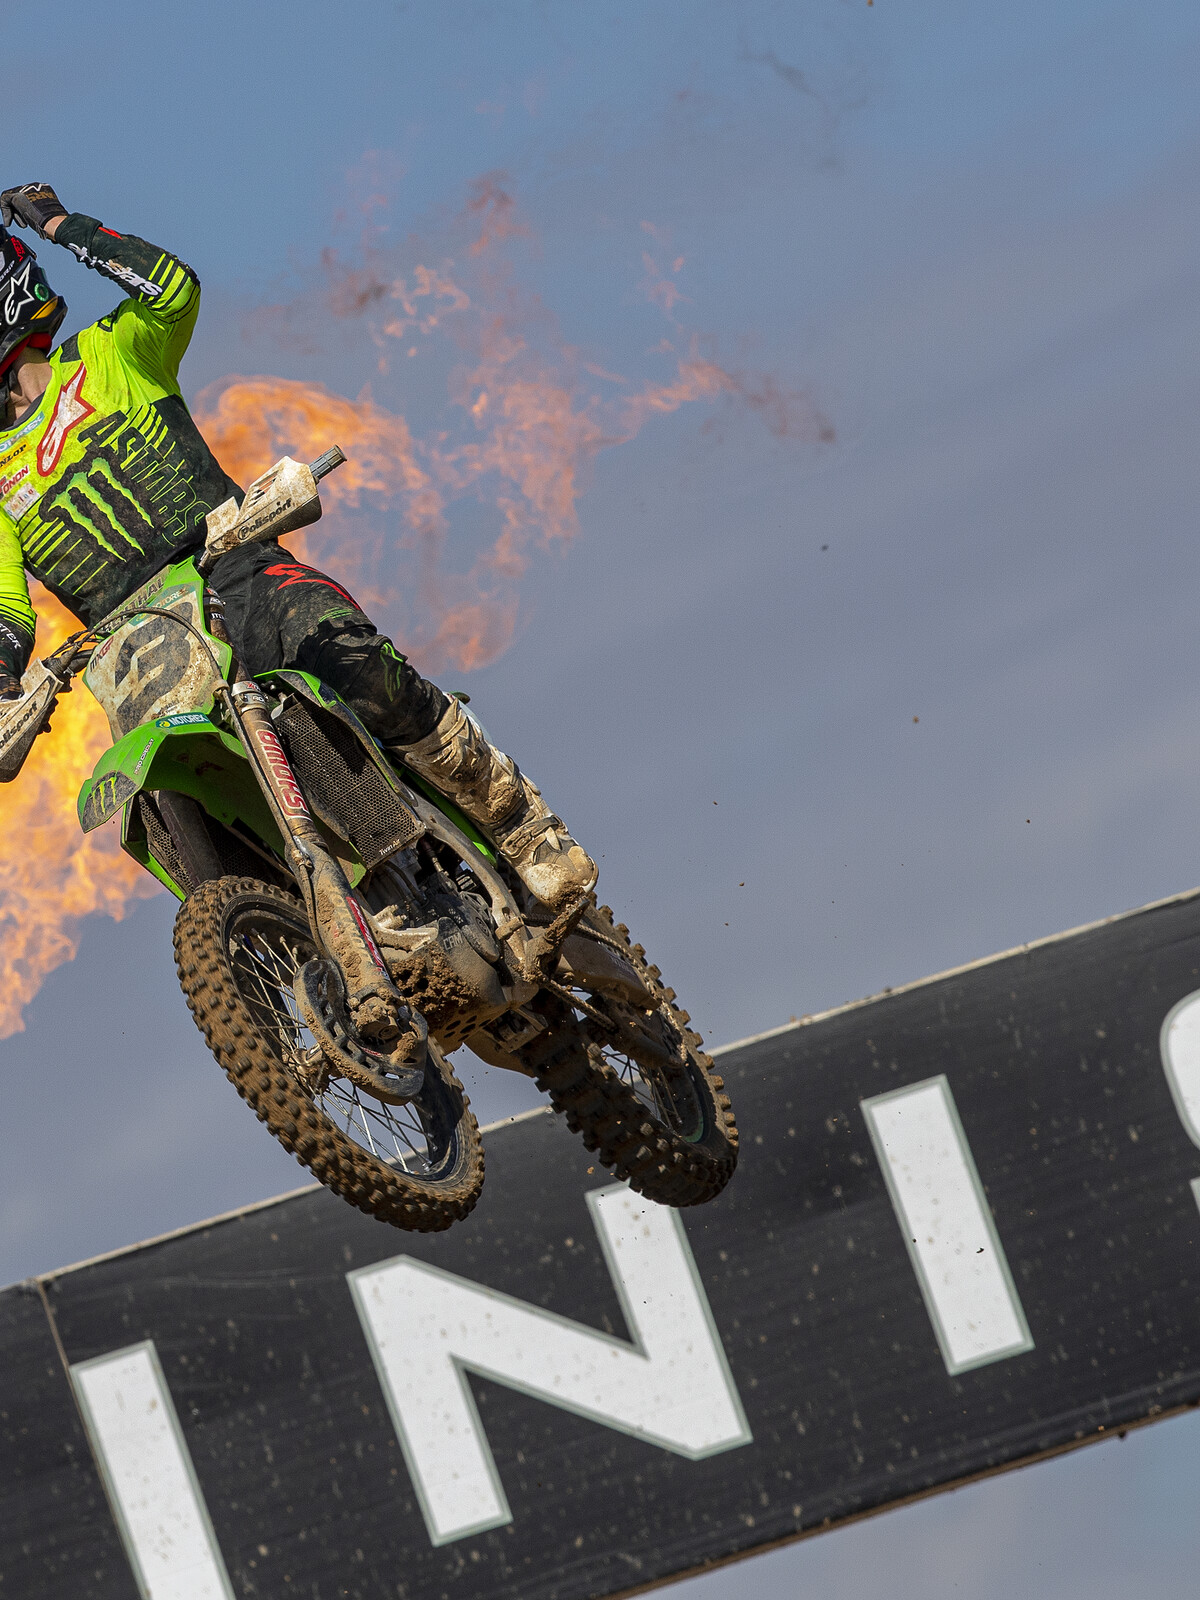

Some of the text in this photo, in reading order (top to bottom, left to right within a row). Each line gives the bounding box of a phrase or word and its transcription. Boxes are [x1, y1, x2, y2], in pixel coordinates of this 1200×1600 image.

[237, 497, 293, 541] Polisport
[155, 588, 189, 609] OTOREX
[168, 714, 209, 726] MOTOREX
[255, 728, 311, 815] SHOWA
[379, 844, 394, 855] Twin
